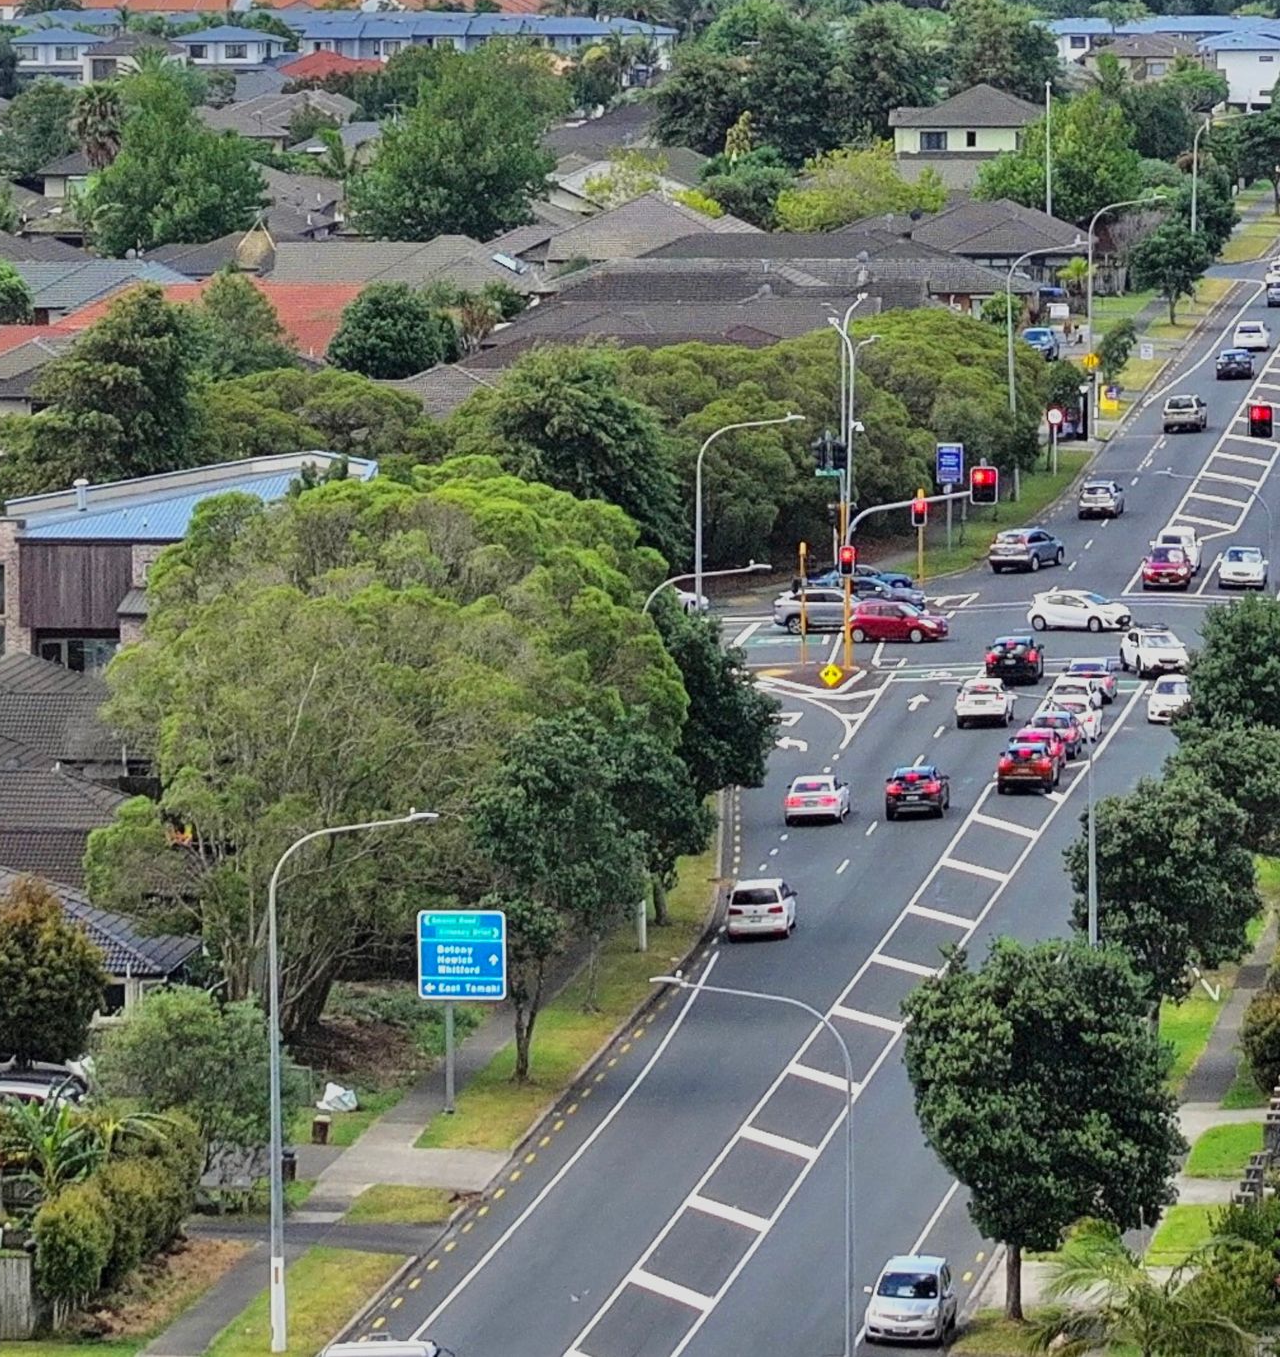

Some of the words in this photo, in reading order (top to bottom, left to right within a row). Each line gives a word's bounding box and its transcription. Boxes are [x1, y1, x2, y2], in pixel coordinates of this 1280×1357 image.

[437, 945, 473, 956] Botany
[438, 965, 480, 974] Whitford
[438, 983, 460, 992] East
[465, 984, 500, 993] Tamaki
